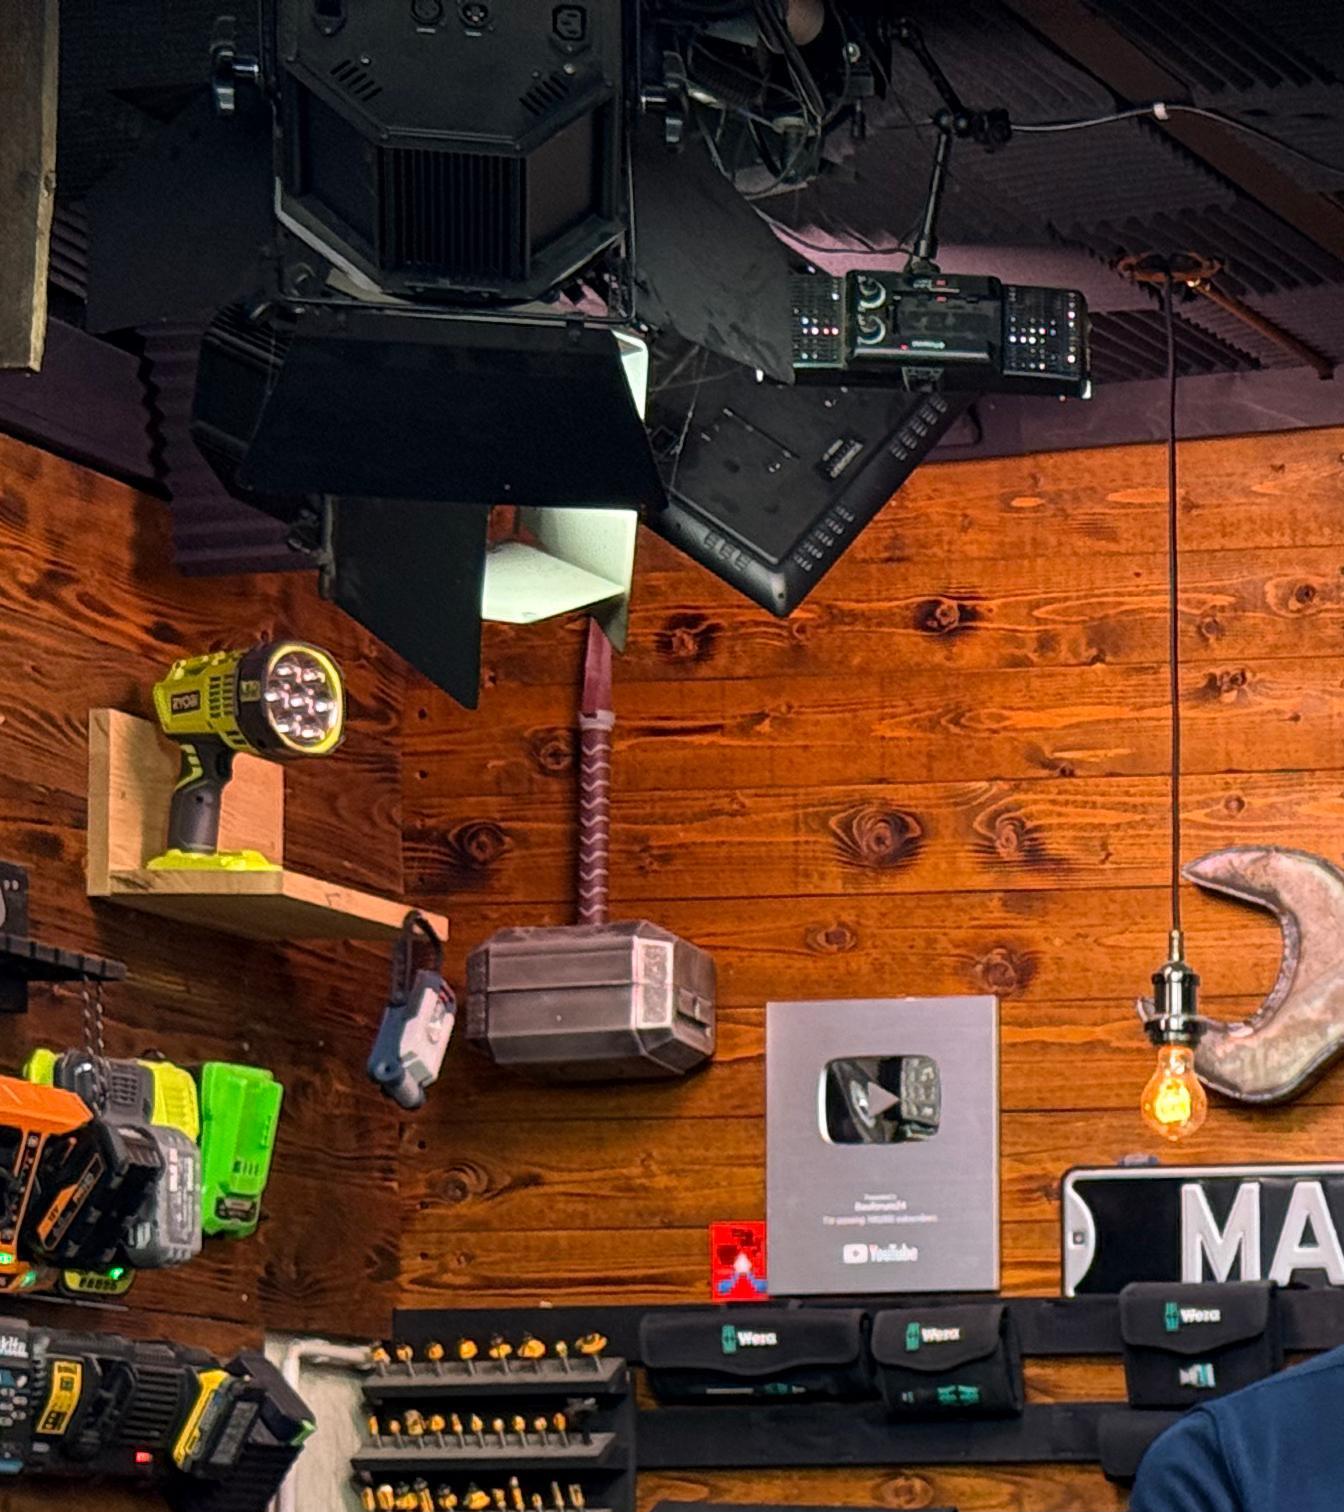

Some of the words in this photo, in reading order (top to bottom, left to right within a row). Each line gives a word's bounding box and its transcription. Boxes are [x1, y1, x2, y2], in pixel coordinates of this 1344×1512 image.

[1180, 1307, 1221, 1325] Wera
[737, 1331, 778, 1346] Wera
[921, 1327, 960, 1342] Wera
